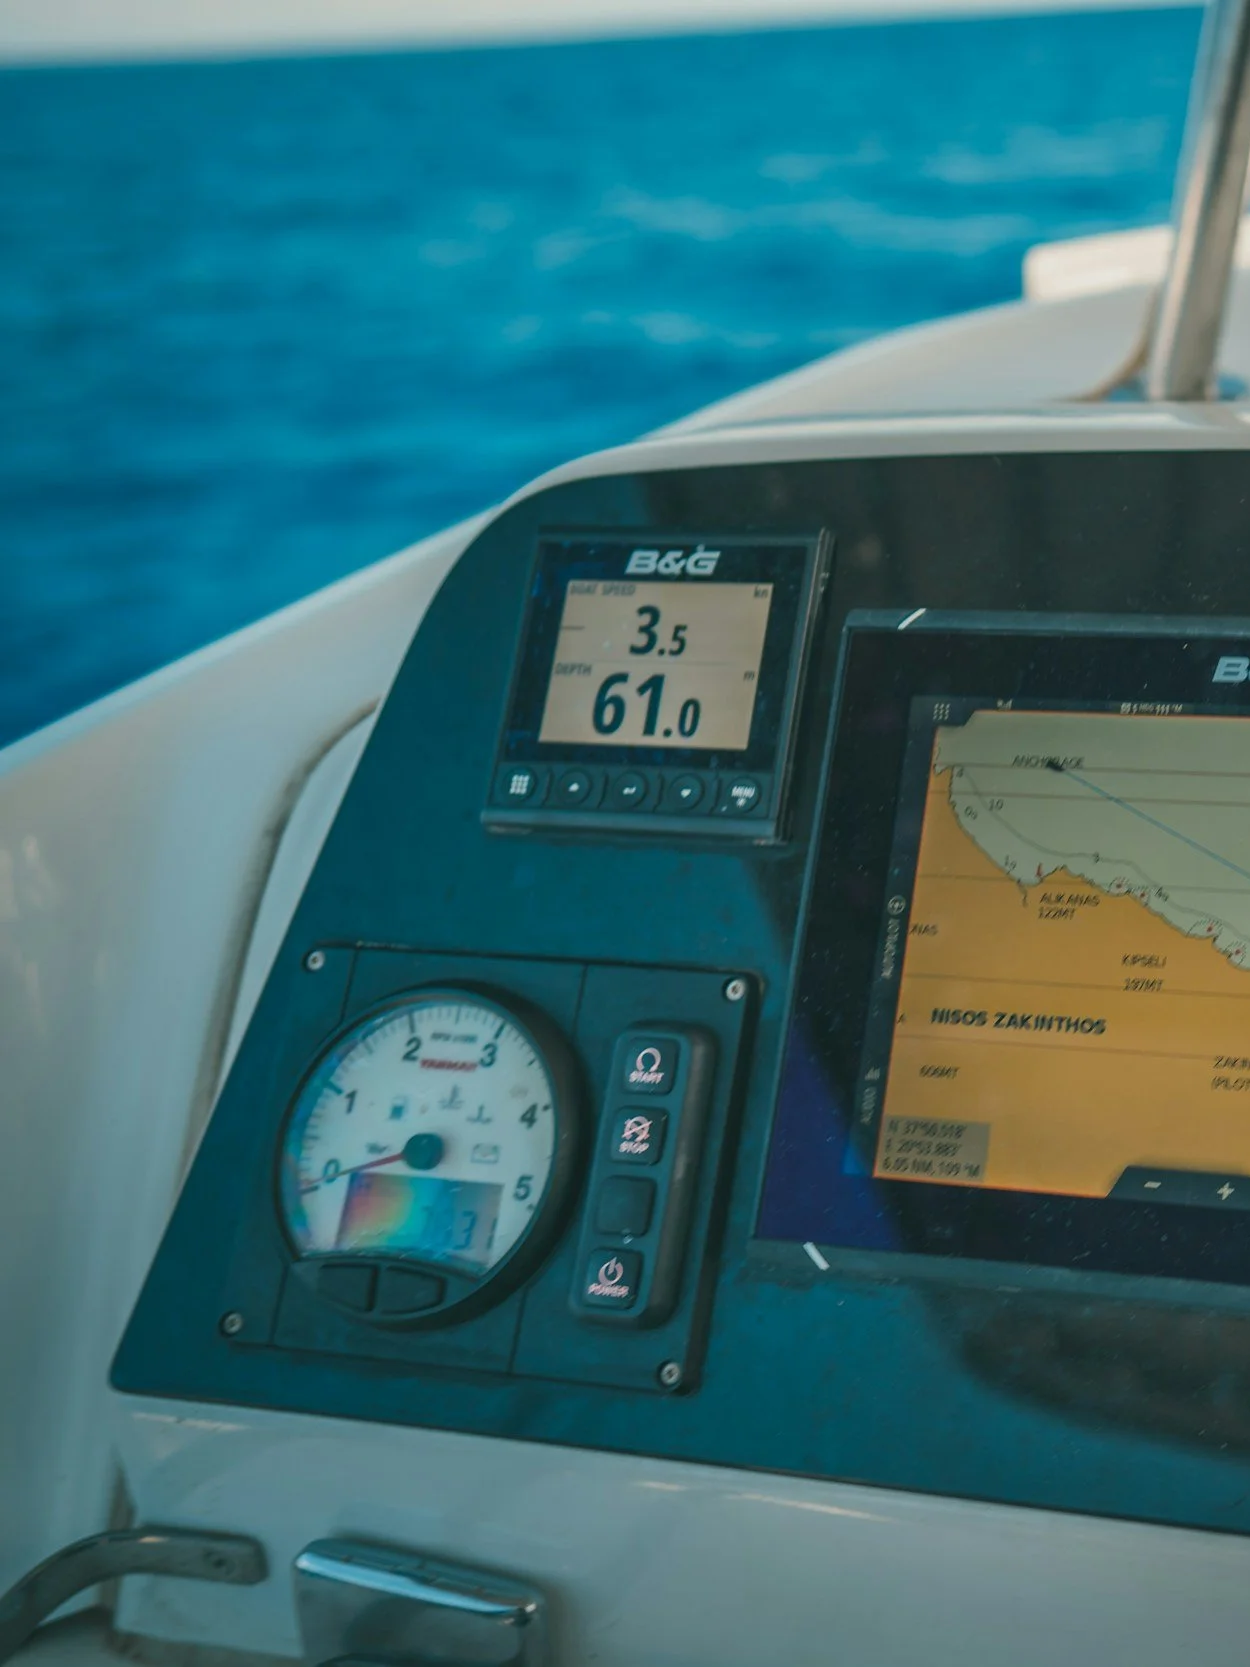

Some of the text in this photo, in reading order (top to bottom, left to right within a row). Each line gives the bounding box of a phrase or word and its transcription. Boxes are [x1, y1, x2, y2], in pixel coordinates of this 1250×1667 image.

[624, 549, 721, 576] B&G
[629, 604, 688, 657] 3.5
[554, 663, 592, 677] DEPTH
[592, 672, 702, 739] 61.0
[929, 1007, 989, 1027] NISOS
[993, 1011, 1107, 1035] ZAKINTHOS
[402, 1036, 422, 1062] 2
[479, 1042, 498, 1068] 3
[344, 1089, 357, 1114] 1
[519, 1103, 540, 1129] 4
[321, 1157, 342, 1185] 0
[513, 1174, 534, 1201] 5
